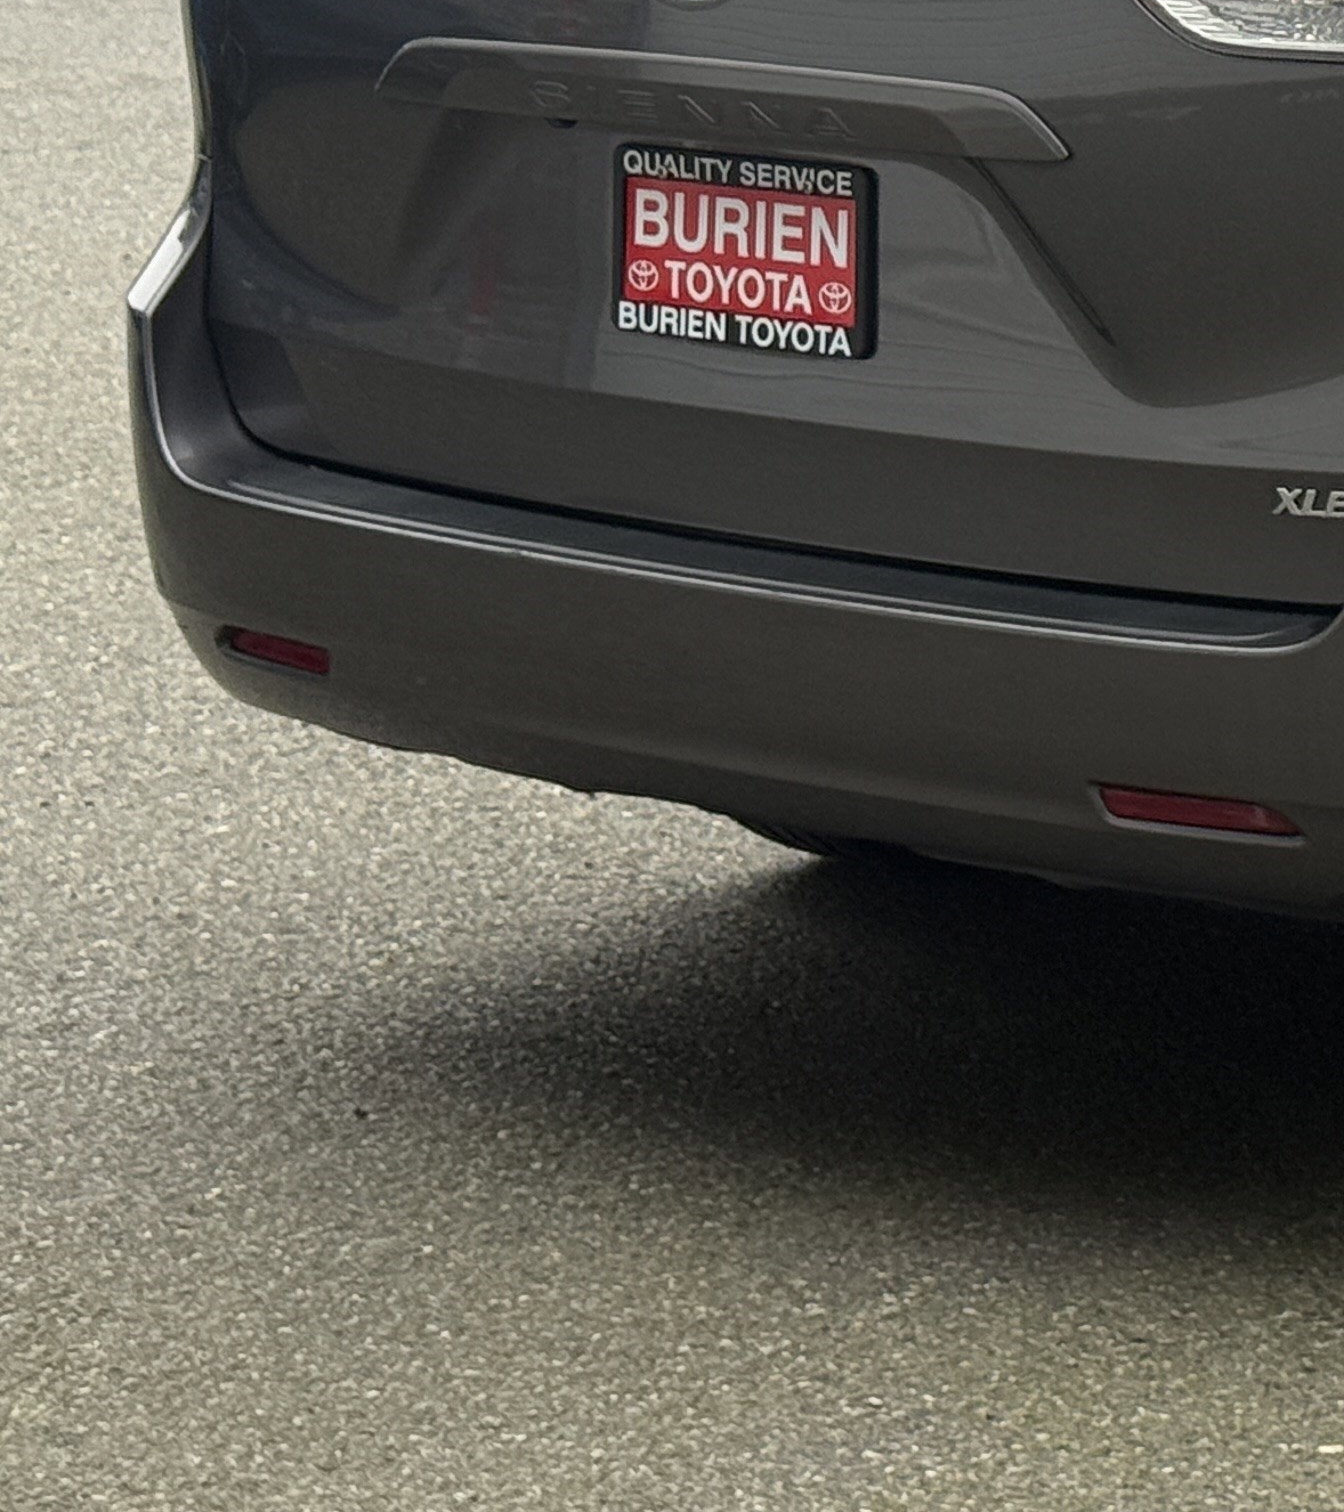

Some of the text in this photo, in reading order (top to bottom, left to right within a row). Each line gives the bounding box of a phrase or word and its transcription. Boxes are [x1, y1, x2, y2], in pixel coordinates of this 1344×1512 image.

[623, 149, 853, 197] QUALITY SERVICE
[633, 187, 849, 268] BURIEN
[664, 258, 813, 315] TOYOTA
[618, 300, 852, 357] BURIEN TOYOTA
